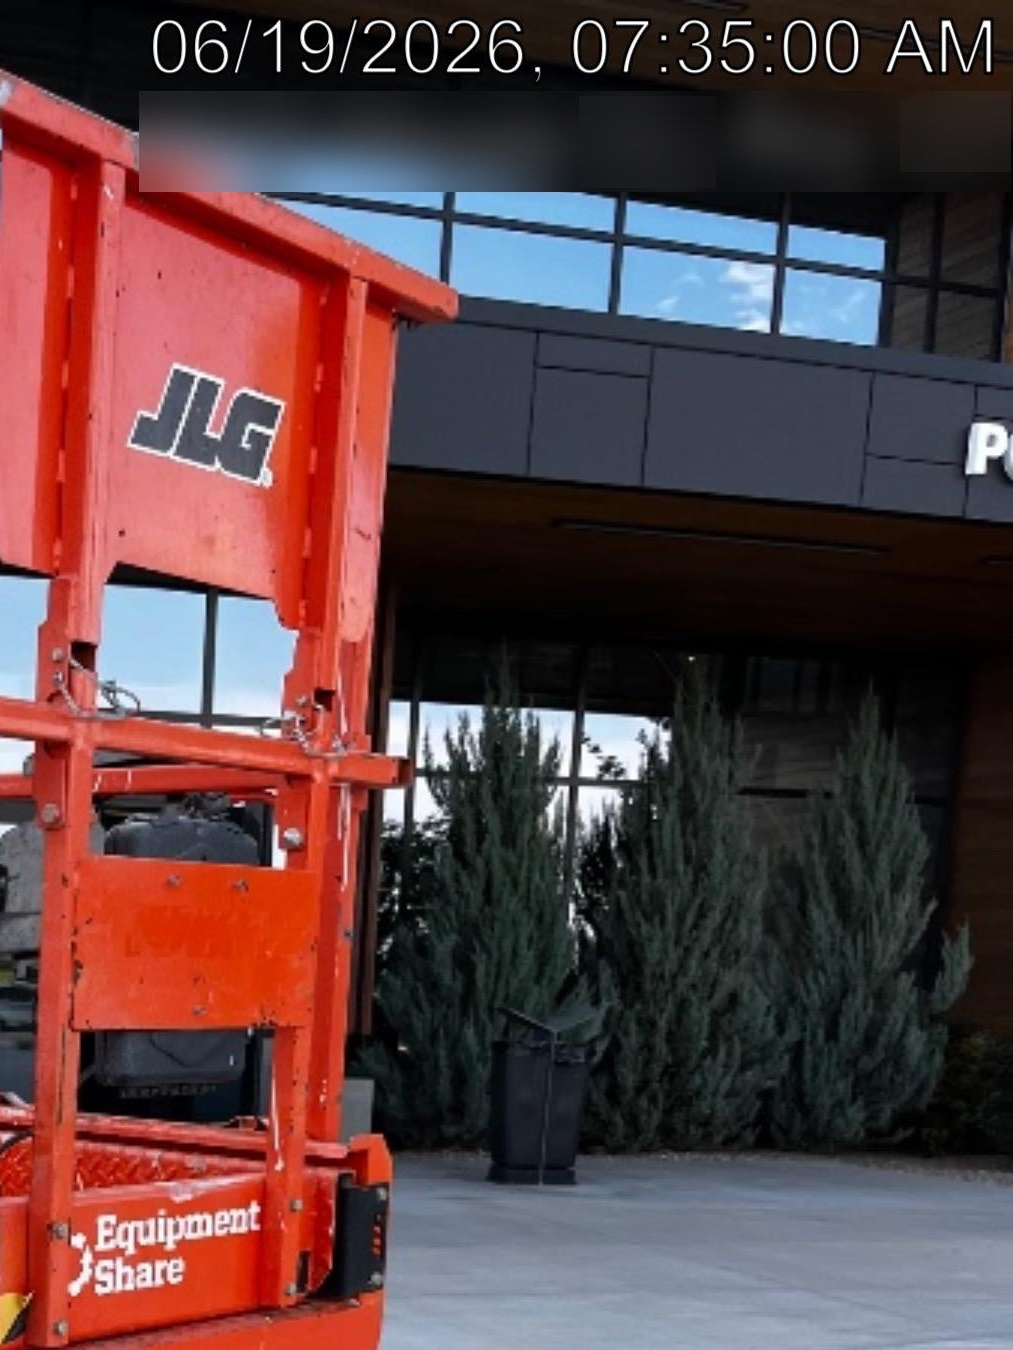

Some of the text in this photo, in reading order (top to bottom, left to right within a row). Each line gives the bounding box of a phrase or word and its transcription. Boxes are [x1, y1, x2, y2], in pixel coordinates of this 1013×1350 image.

[128, 363, 285, 487] JLG
[965, 421, 1013, 482] P
[94, 1199, 262, 1256] Equipment
[94, 1256, 185, 1296] Share
